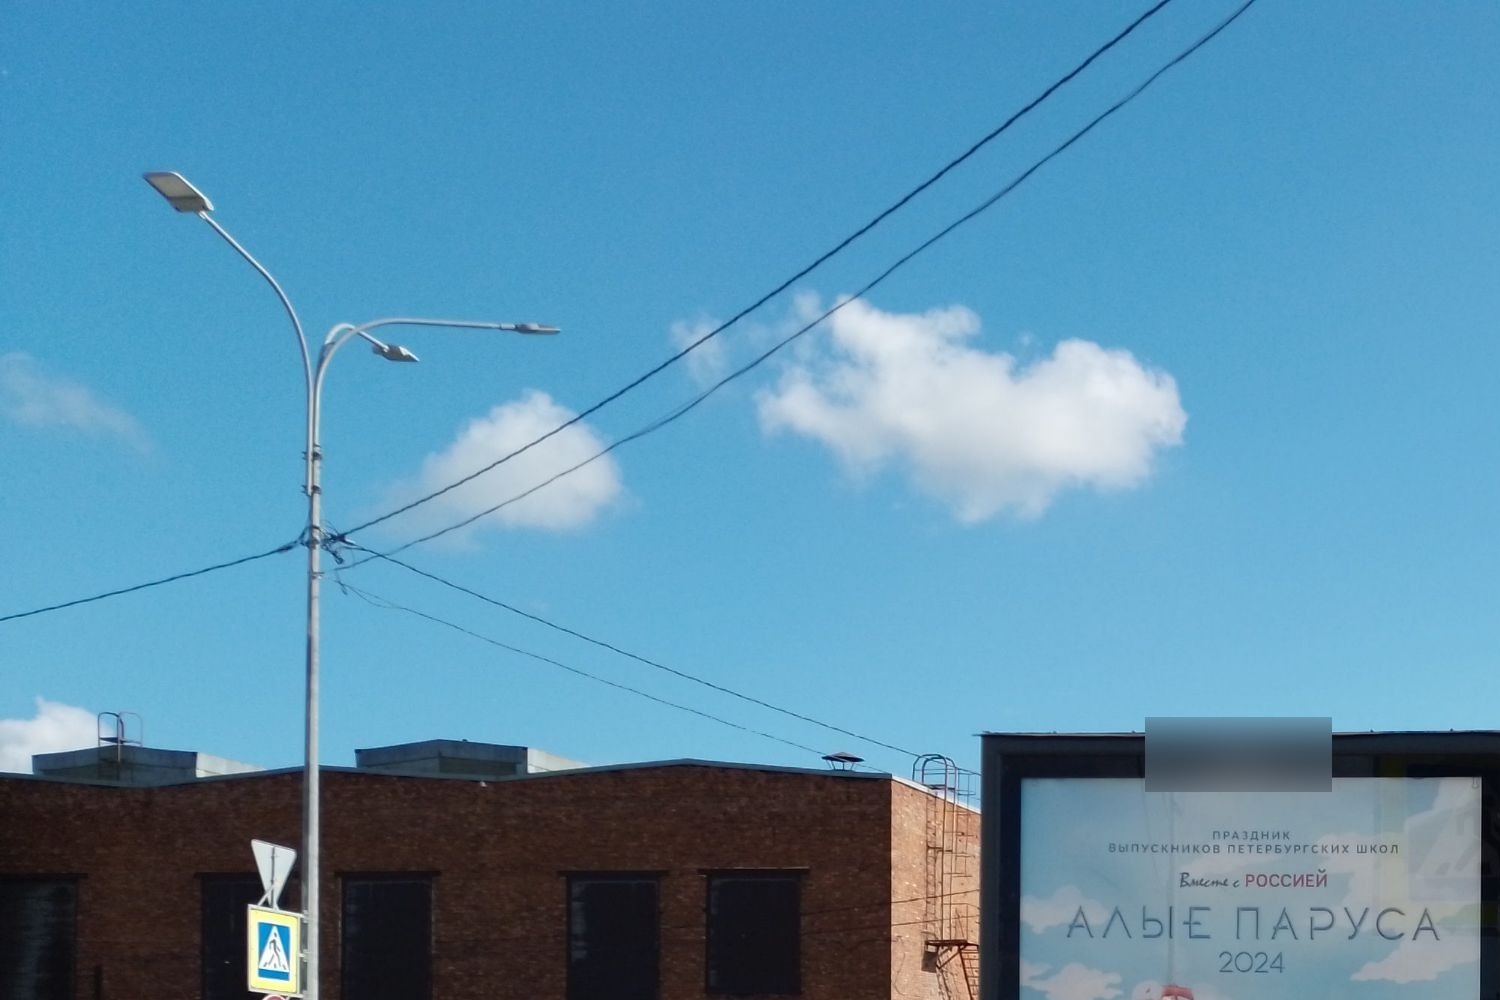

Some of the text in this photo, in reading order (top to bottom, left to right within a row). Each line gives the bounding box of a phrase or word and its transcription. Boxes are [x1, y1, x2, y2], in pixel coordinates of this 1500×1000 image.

[1212, 830, 1290, 841] ПРАЗДНИК
[1108, 843, 1399, 854] ВЫПУСКНИКОВ ПЕТЕРБУРГСКИХ ШКОЛ
[1179, 868, 1328, 889] Вместе с РОССИЕЙ
[1066, 905, 1441, 941] АЛЫЕ ПАРУСА
[1218, 951, 1285, 974] 2024
